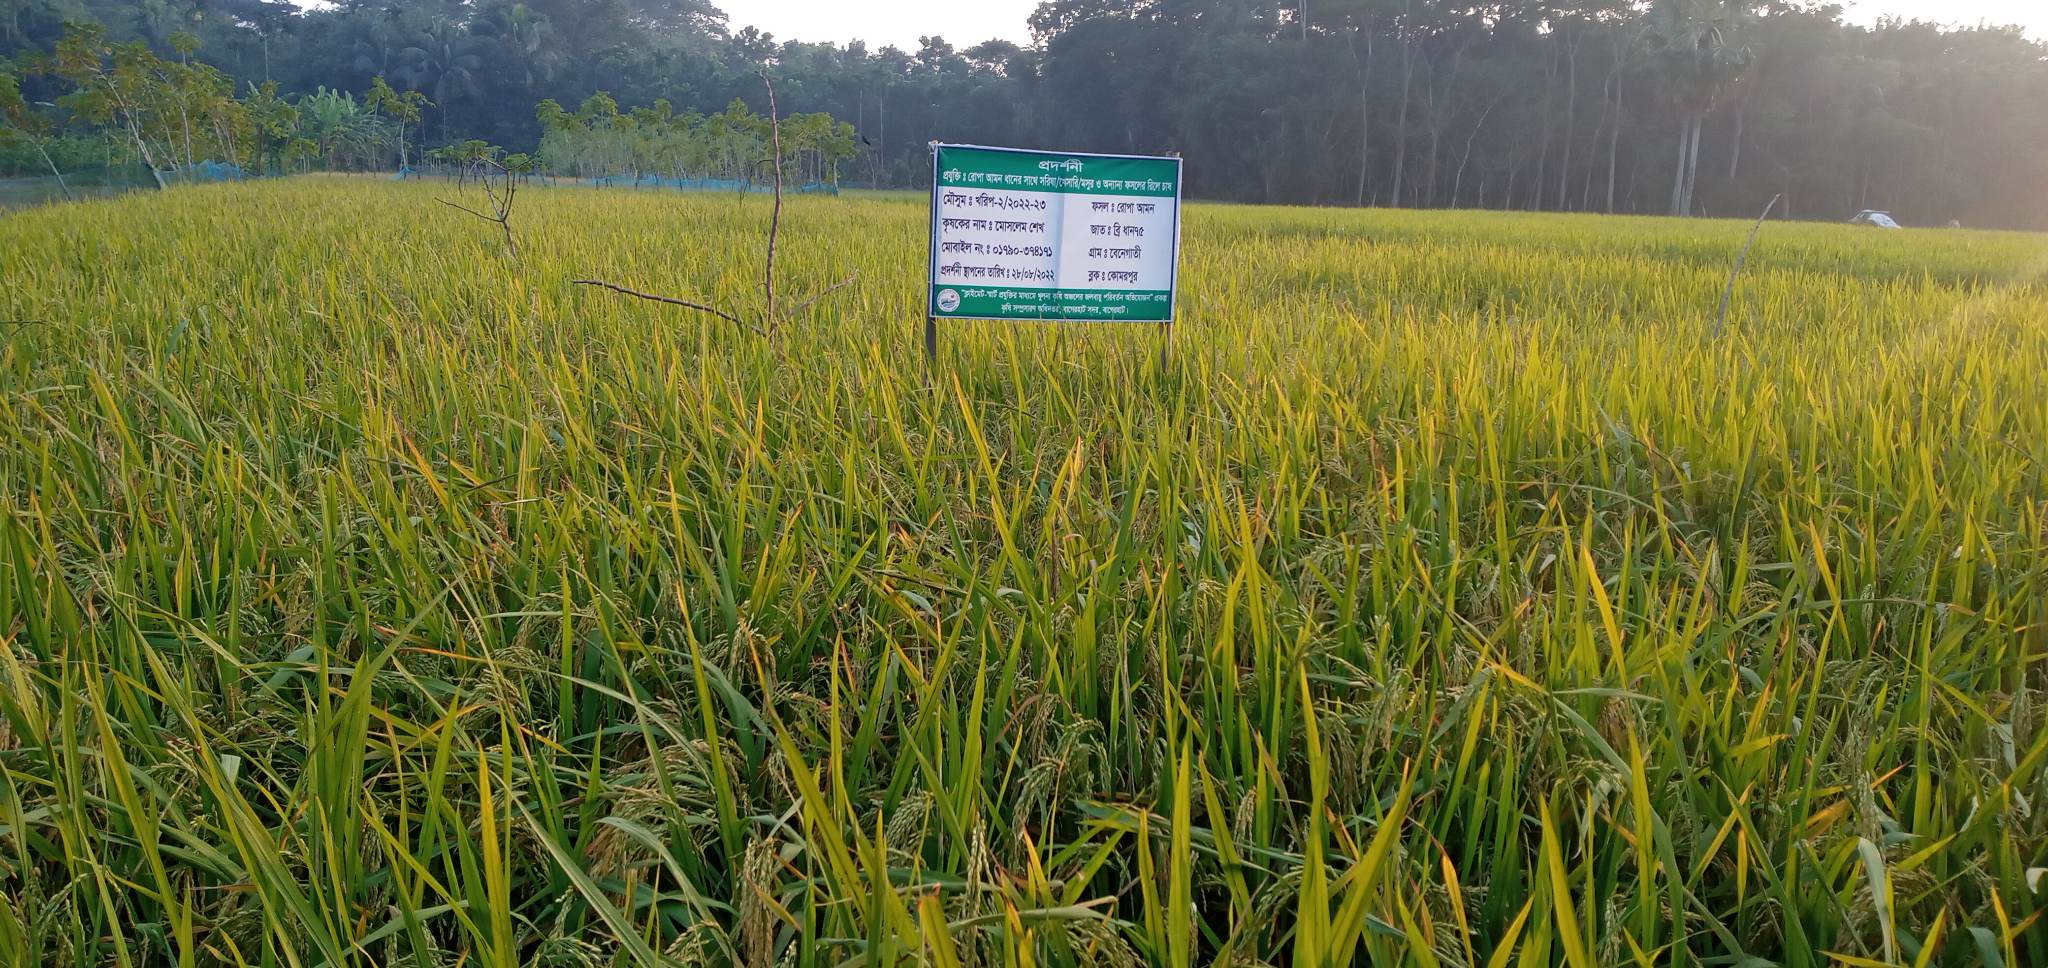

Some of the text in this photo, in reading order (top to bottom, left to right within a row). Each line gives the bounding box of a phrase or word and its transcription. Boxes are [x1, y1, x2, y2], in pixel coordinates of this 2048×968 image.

[1039, 159, 1084, 173] প্রদর্শনী
[943, 168, 961, 183] প্রযুক্তি
[968, 173, 984, 182] রোপা
[986, 174, 1003, 184] আমন
[1005, 174, 1022, 184] ধানের
[1024, 175, 1038, 185] সাথে
[1103, 180, 1123, 190] অন্যান্য
[1125, 181, 1146, 190] ফসলের
[1147, 179, 1161, 191] রিলে
[943, 191, 966, 208] মৌসুম
[976, 193, 1046, 210] খরিপ-২/২০২২-২৩
[1092, 202, 1109, 212] ফসল
[1117, 203, 1135, 213] রোপা
[1137, 204, 1155, 214] আমন
[942, 218, 970, 233] কৃষকের
[972, 220, 986, 231] নাম
[995, 221, 1027, 232] মোসলেম
[1029, 223, 1045, 233] শেখ
[1090, 225, 1106, 236] জাত
[1113, 222, 1121, 237] ব্রি
[1123, 226, 1144, 236] ধান৭৫
[942, 240, 972, 253] মোবাইল
[975, 244, 984, 255] নং
[993, 245, 1052, 257] ০১৭৯০-৩৭৪১৭১
[1089, 248, 1102, 258] গ্রাম
[1110, 245, 1141, 259] বেনেগাতী
[941, 262, 961, 277] প্রদর্শনী
[963, 266, 985, 279] স্থাপনের
[988, 265, 1005, 278] তারিখ
[1012, 268, 1054, 281] ২৮/০৮/২০২২
[1088, 270, 1100, 282] ব্লক
[1108, 271, 1138, 283] কোমরপুর
